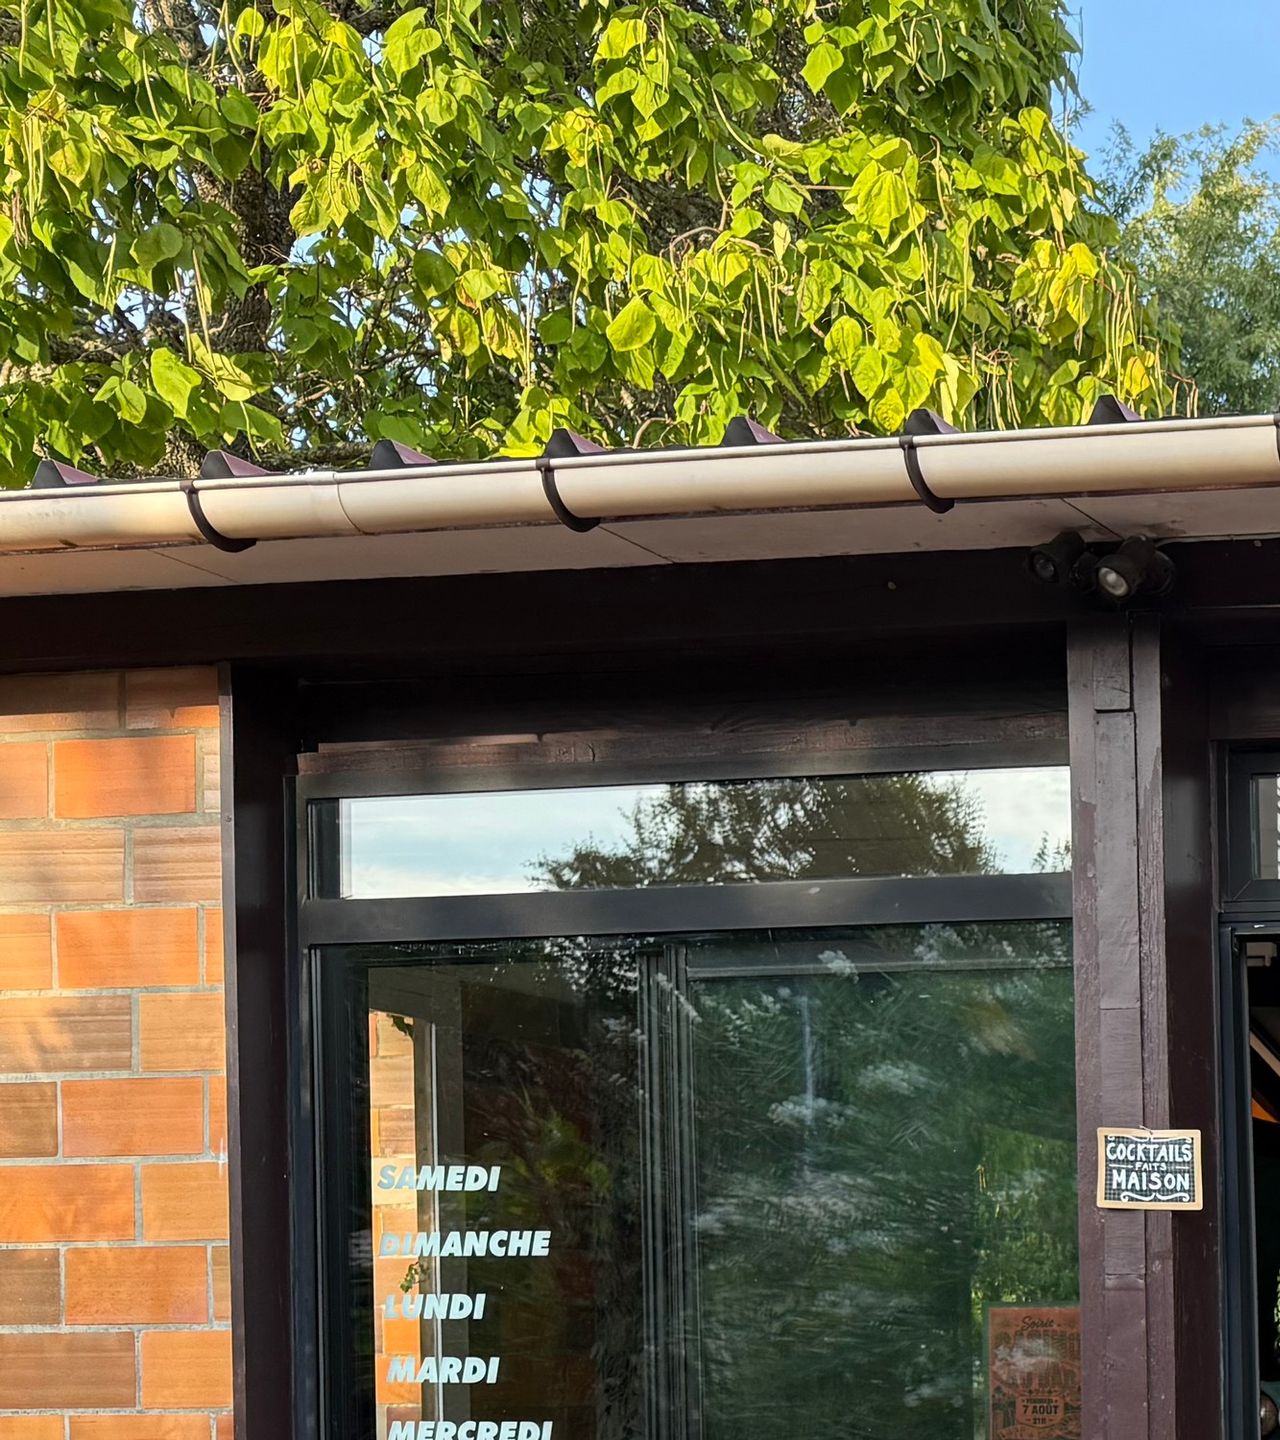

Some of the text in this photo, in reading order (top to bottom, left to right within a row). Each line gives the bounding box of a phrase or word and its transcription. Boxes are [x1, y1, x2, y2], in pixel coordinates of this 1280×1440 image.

[1106, 1142, 1192, 1162] COCKTAILS
[377, 1165, 501, 1192] SAMEDI
[1135, 1162, 1167, 1171] FAITS
[1112, 1169, 1190, 1191] MAISON
[379, 1231, 551, 1257] DIMANCHE
[384, 1293, 486, 1320] LUNDI
[386, 1357, 500, 1384] MARDI
[1022, 1405, 1029, 1415] 7
